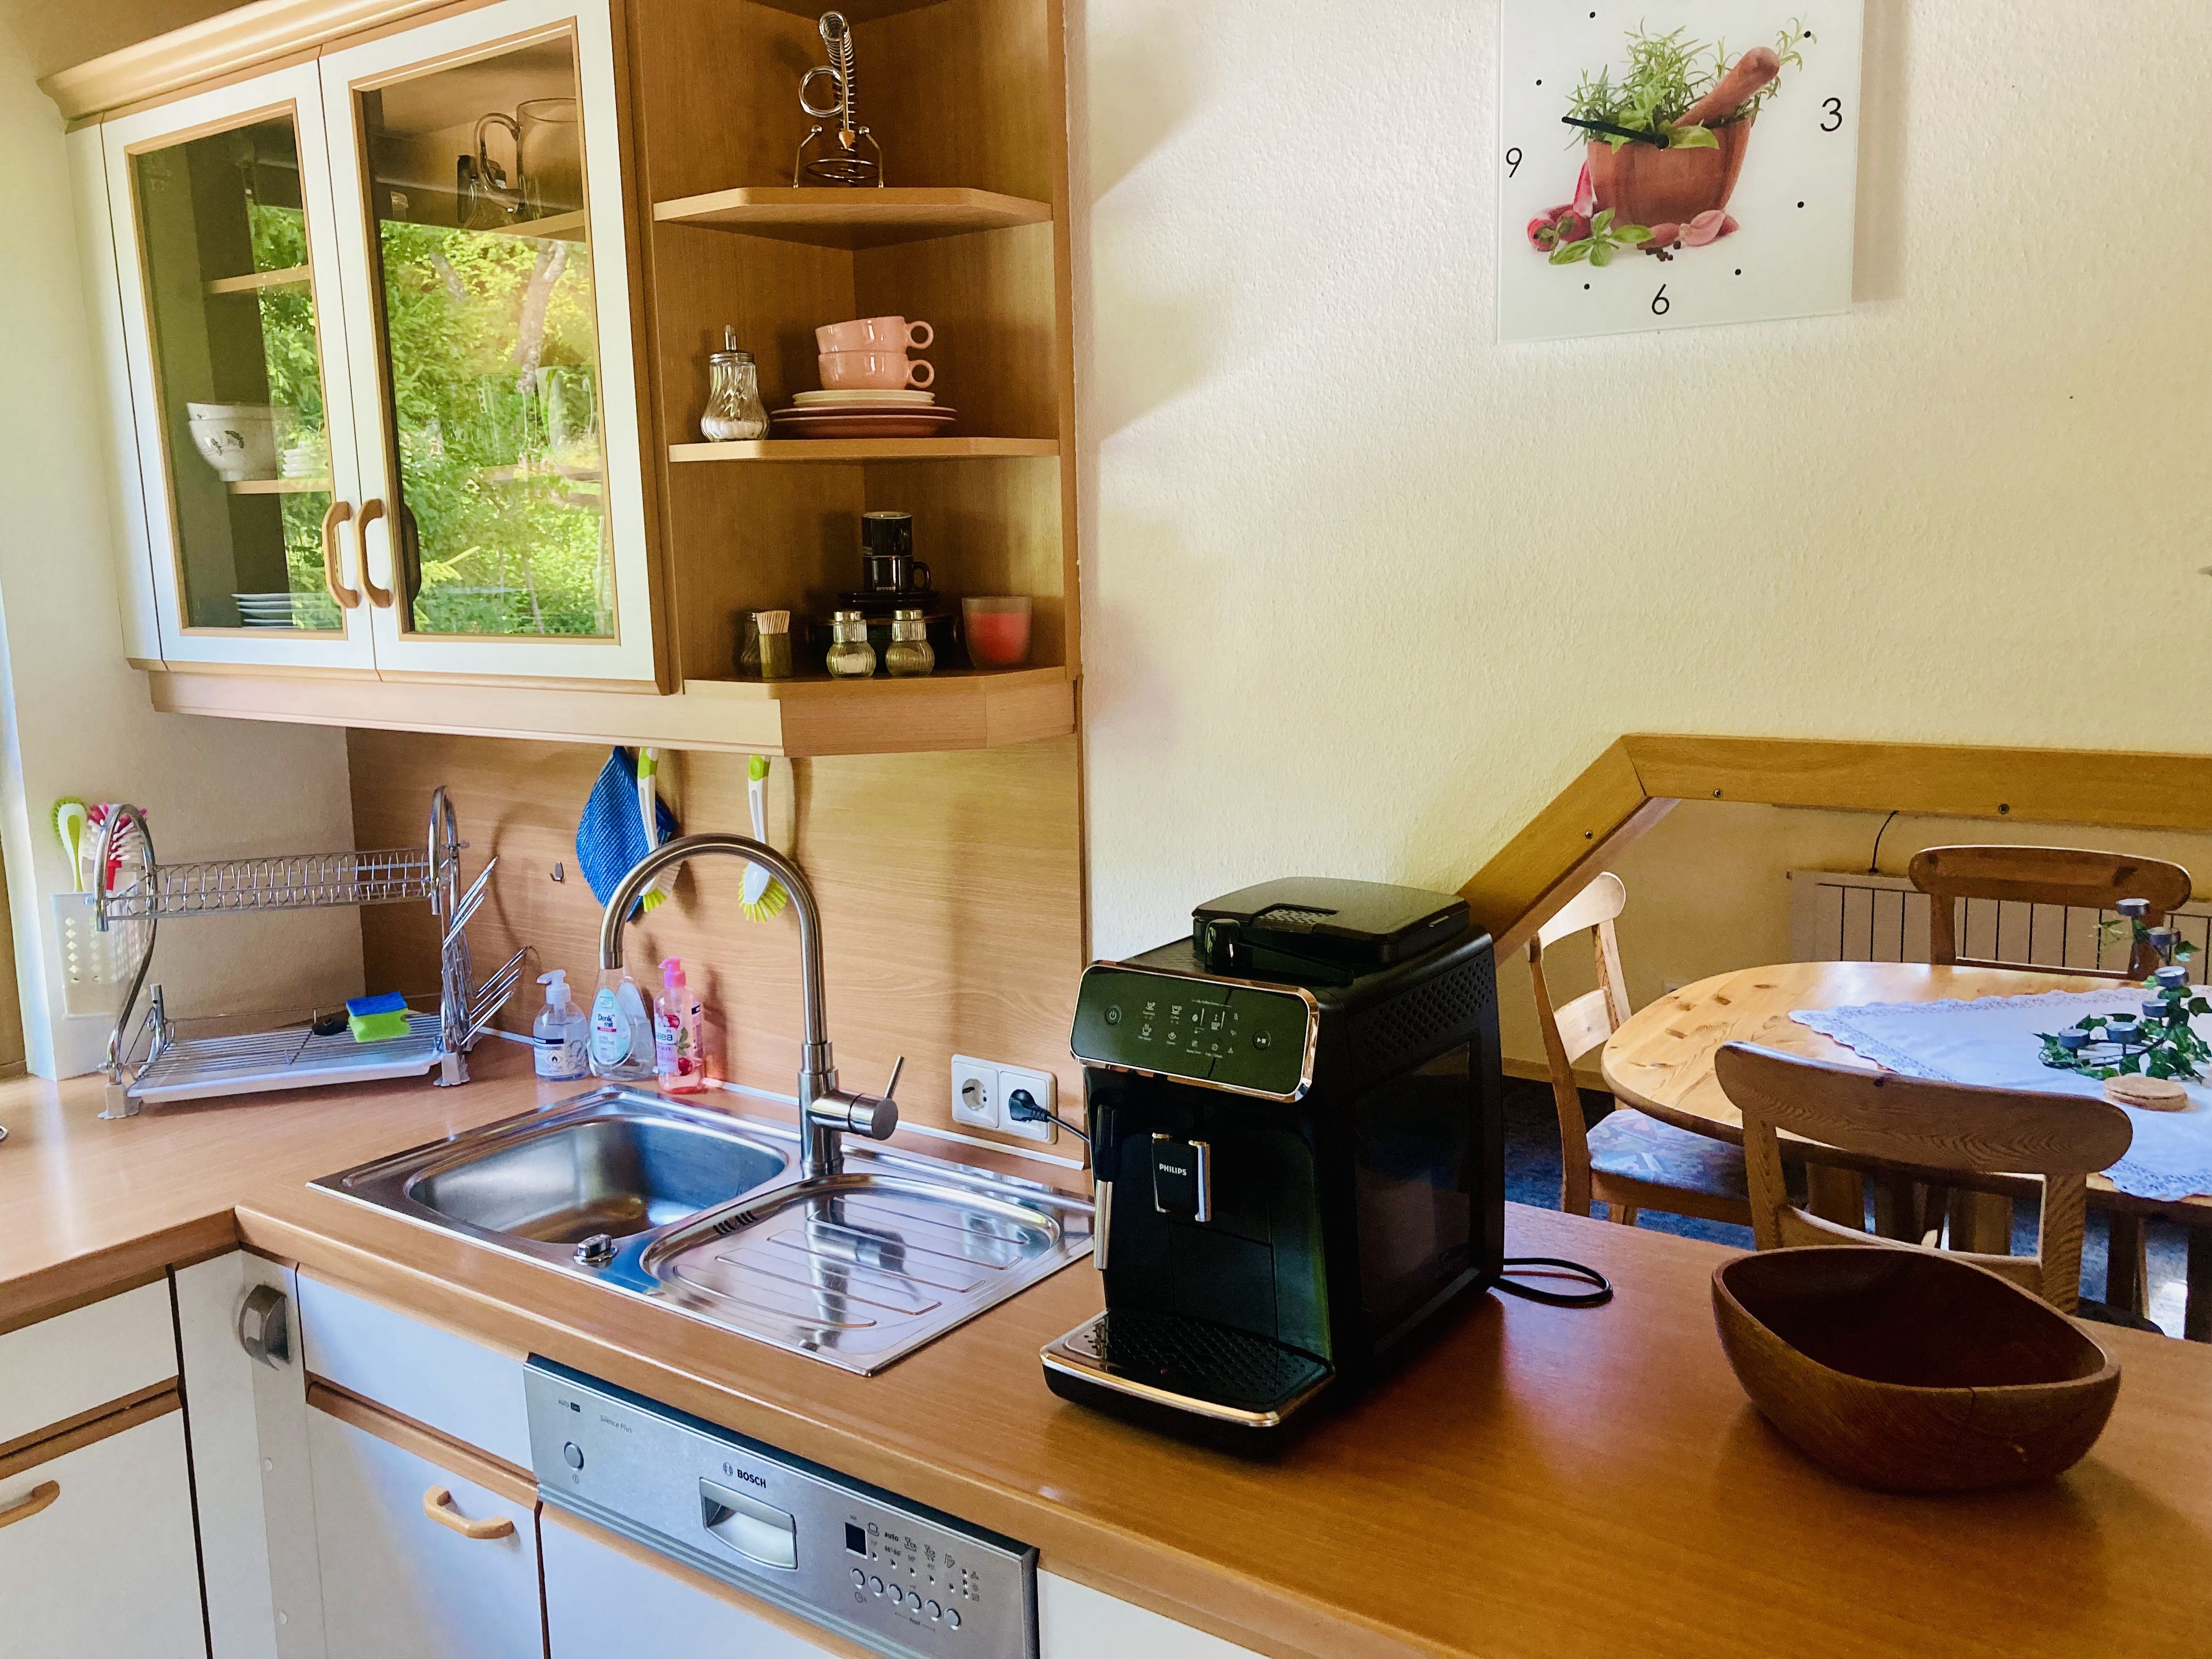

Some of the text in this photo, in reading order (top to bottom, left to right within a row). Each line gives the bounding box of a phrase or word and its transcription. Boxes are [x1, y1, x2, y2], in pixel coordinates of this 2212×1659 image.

[1820, 97, 1843, 132] 3
[1505, 147, 1523, 178] 9
[1651, 283, 1671, 315] 6
[598, 1013, 612, 1022] Denk
[656, 1032, 673, 1041] alea
[1159, 1163, 1187, 1176] PHILIPS
[600, 1414, 619, 1428] Silence
[737, 1469, 766, 1488] BOSCH
[884, 1532, 899, 1542] auto
